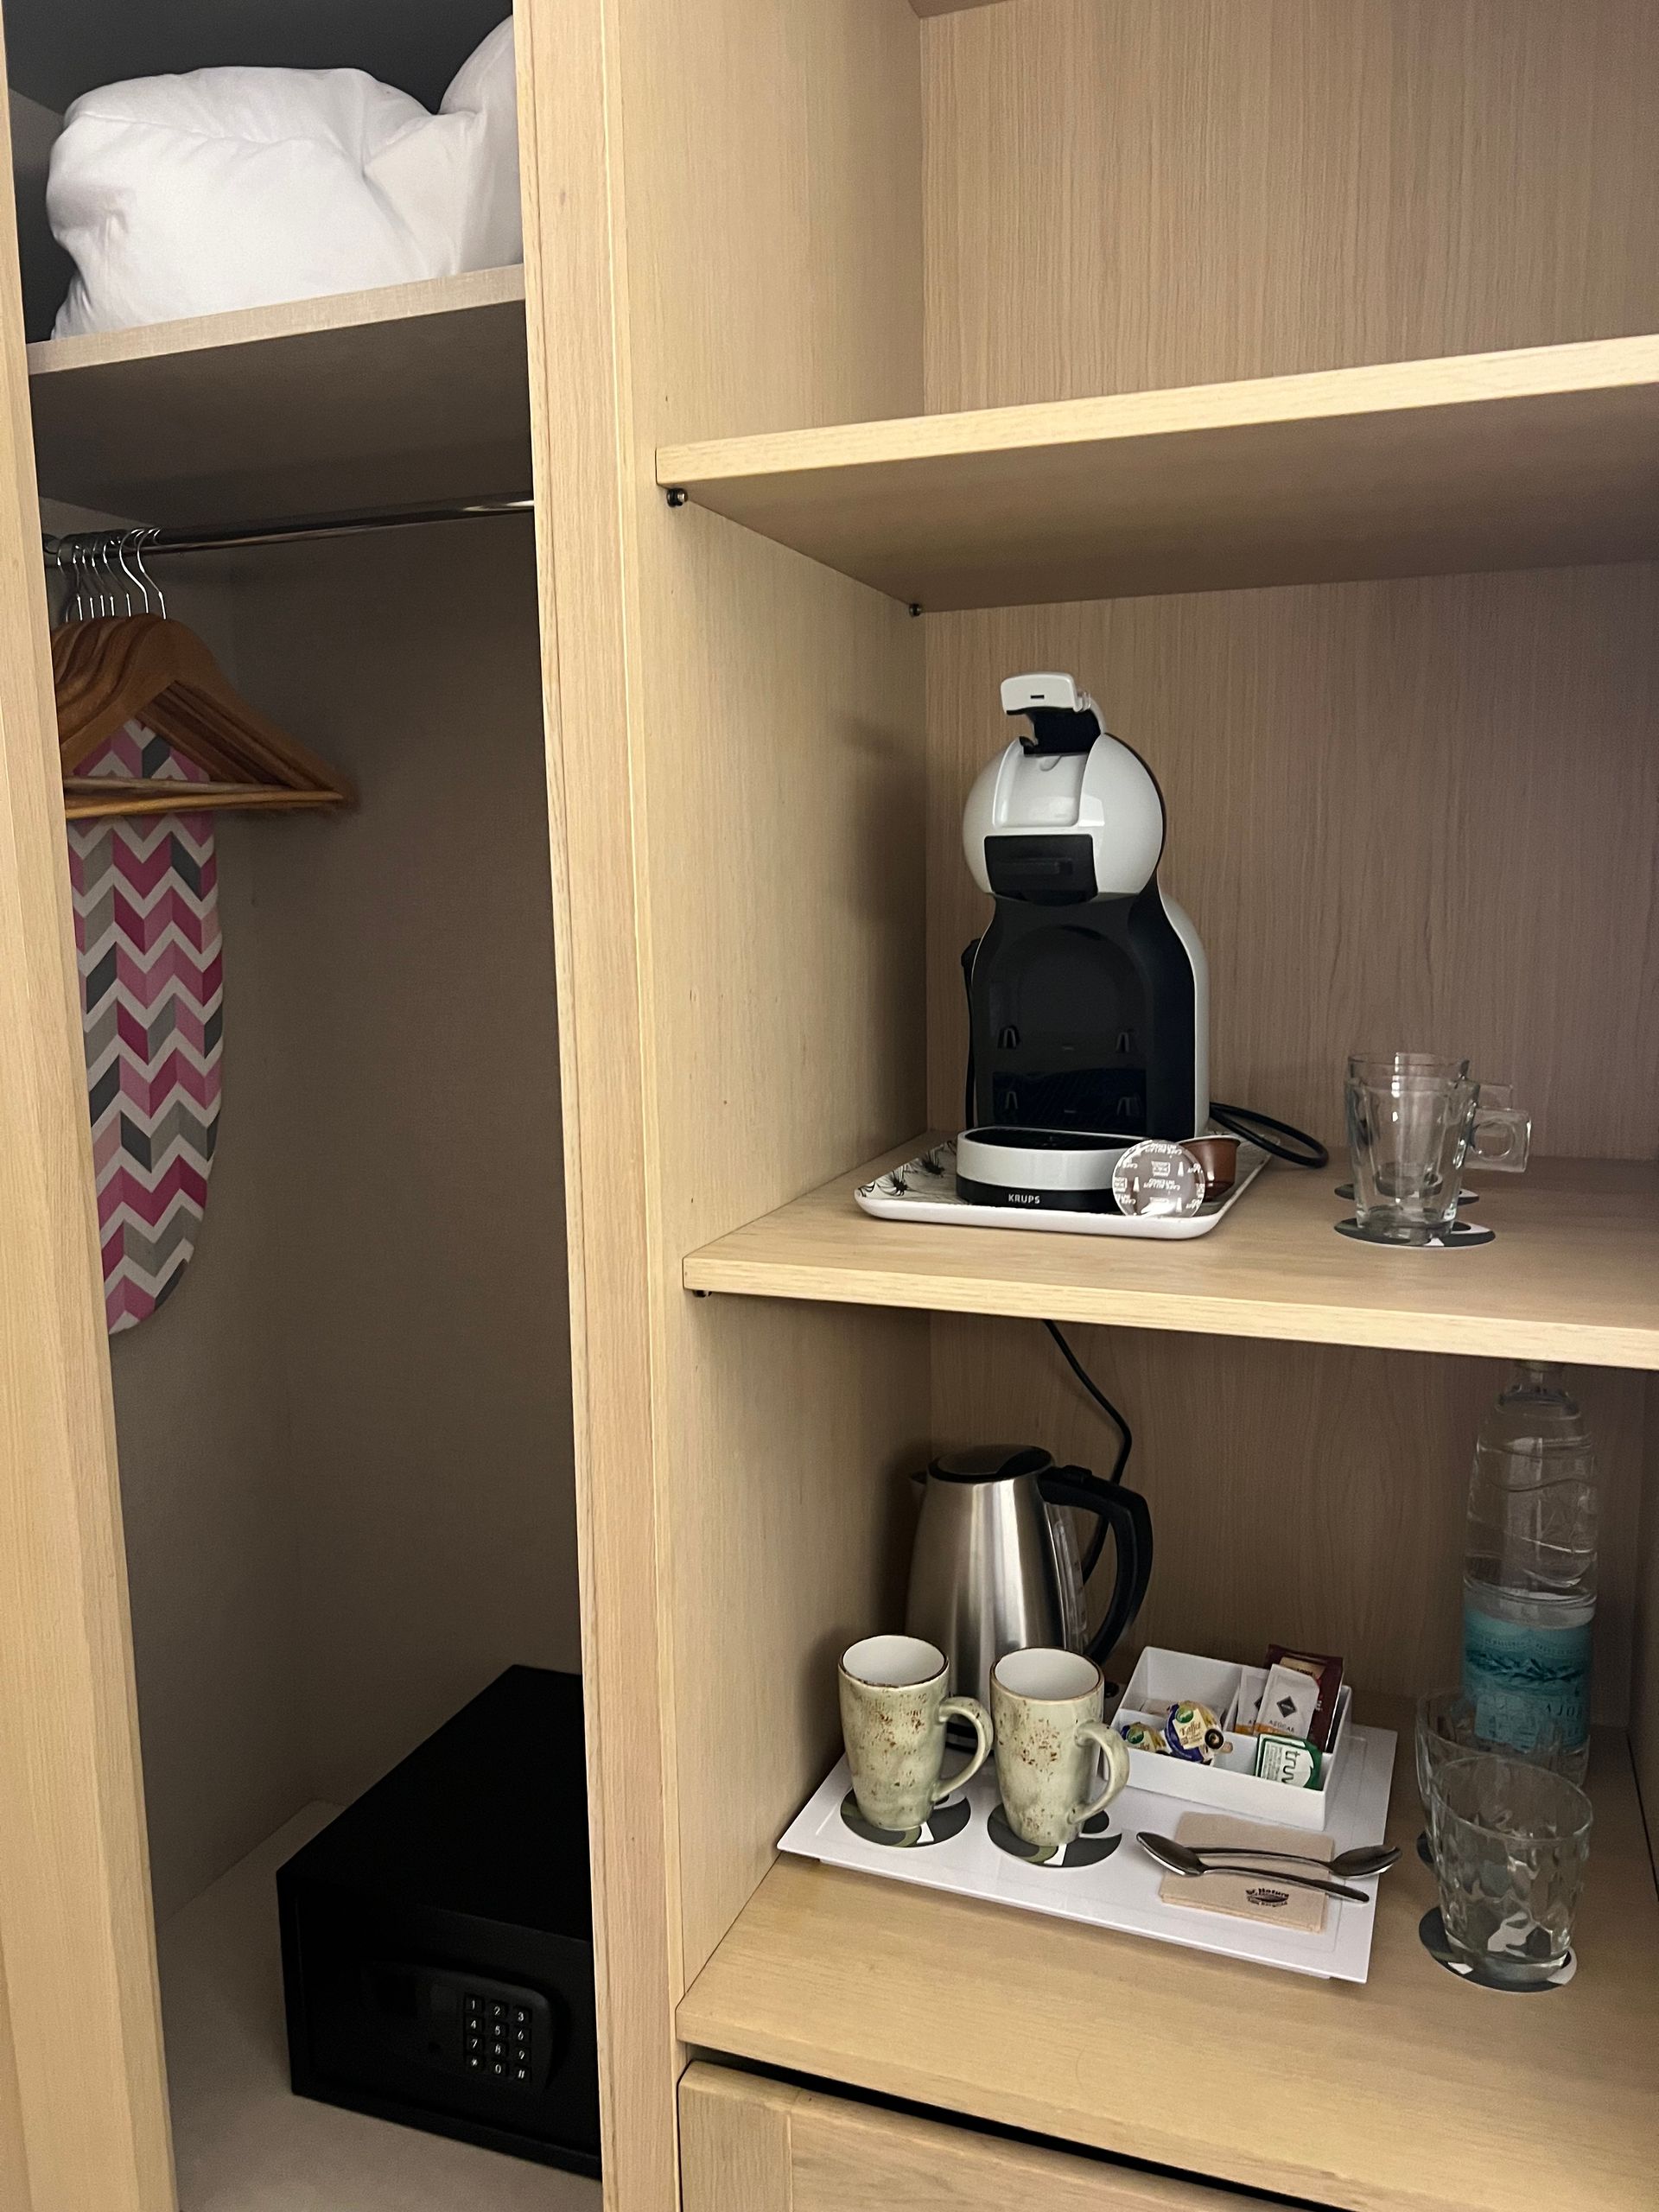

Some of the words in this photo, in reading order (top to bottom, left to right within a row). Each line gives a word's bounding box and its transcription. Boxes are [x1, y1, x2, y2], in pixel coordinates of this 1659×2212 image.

[1008, 1193, 1040, 1205] KRUPS
[471, 1999, 475, 2010] 1
[493, 2005, 501, 2016] 2
[518, 2012, 524, 2022] 3
[470, 2019, 476, 2029] 4
[494, 2025, 501, 2036] 5
[518, 2030, 524, 2040] 6
[471, 2038, 478, 2049] 7
[494, 2044, 501, 2055] 8
[518, 2050, 525, 2060] 9
[494, 2063, 502, 2074] 0
